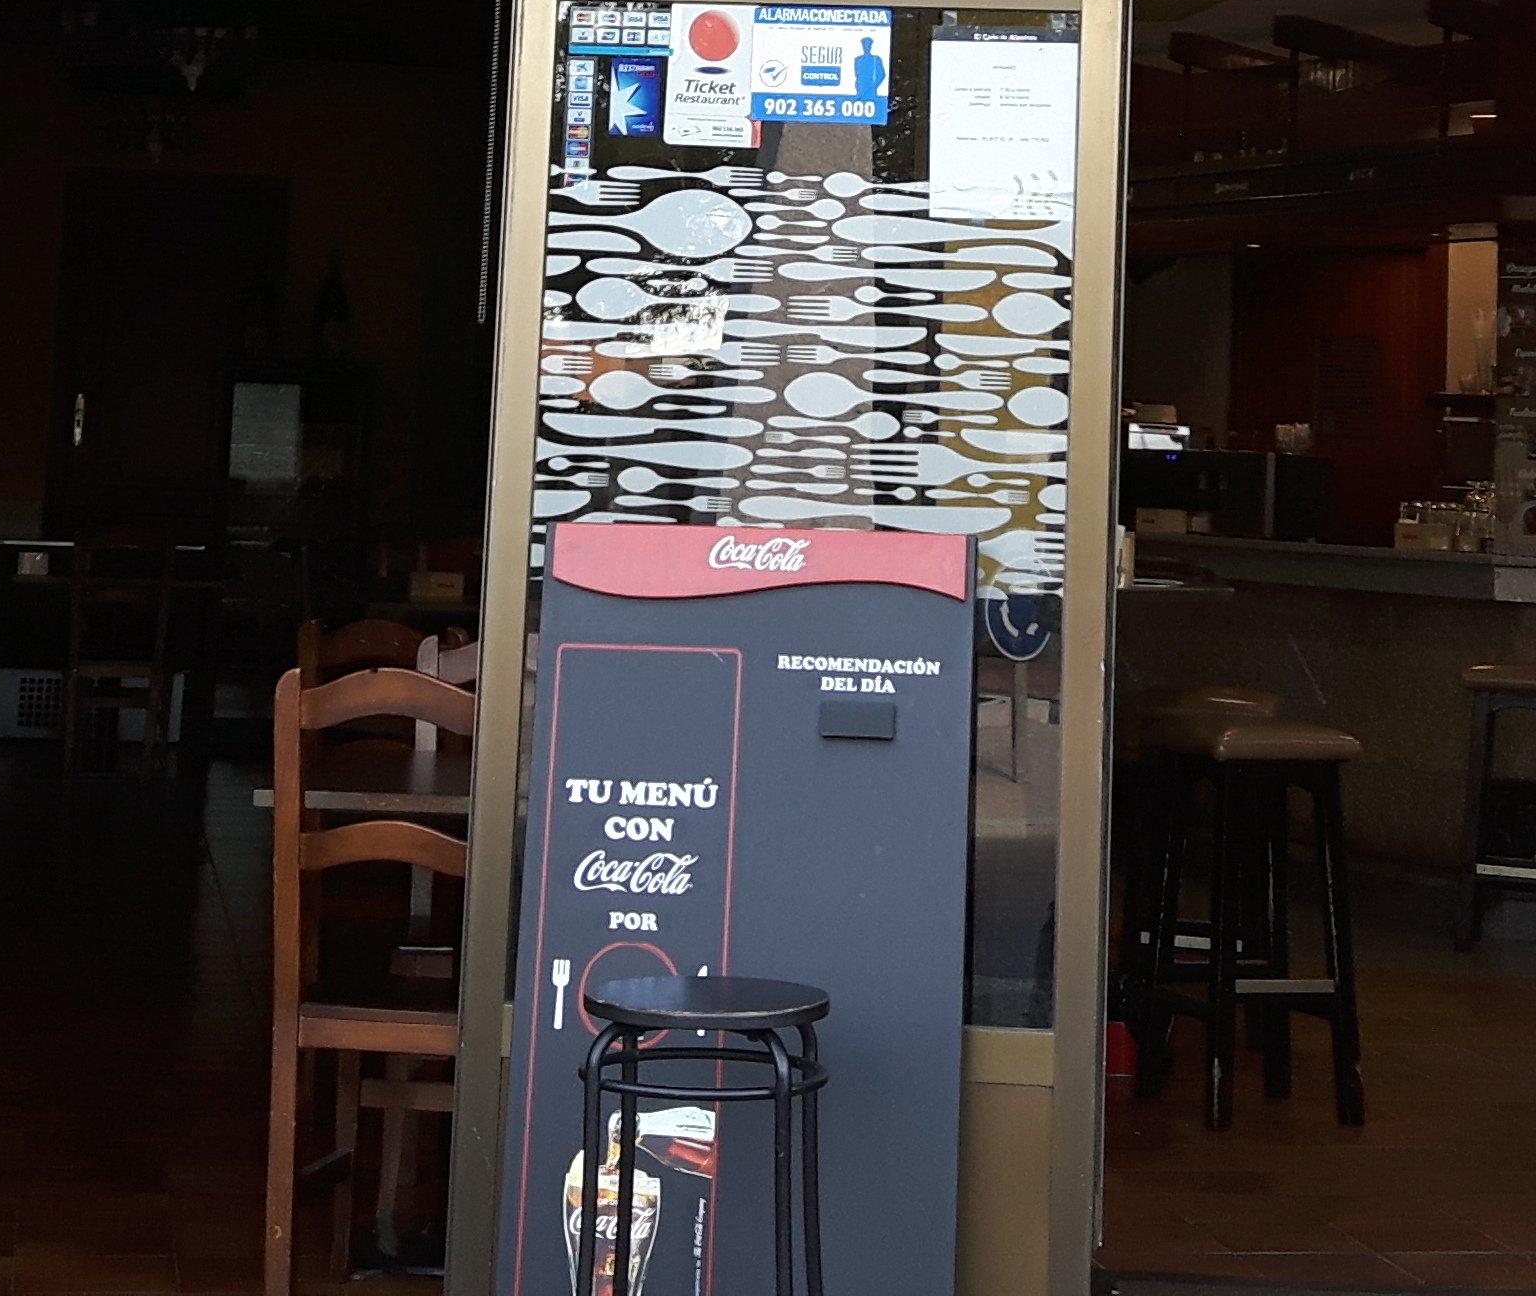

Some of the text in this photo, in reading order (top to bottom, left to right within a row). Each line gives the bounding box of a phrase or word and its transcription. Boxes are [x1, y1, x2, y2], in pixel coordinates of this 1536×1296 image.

[801, 45, 843, 65] SEGUR
[684, 79, 737, 95] Ticket
[802, 72, 840, 81] CONTROL
[764, 98, 875, 118] 902 365 000
[708, 535, 812, 572] Coca-Cola
[777, 654, 941, 676] RECOMENDACIÓN
[820, 675, 896, 694] DEL DÍA
[565, 777, 719, 809] TU MENÚ
[604, 816, 675, 842] CON
[573, 849, 700, 896] Coca-Cola
[608, 911, 658, 932] POR
